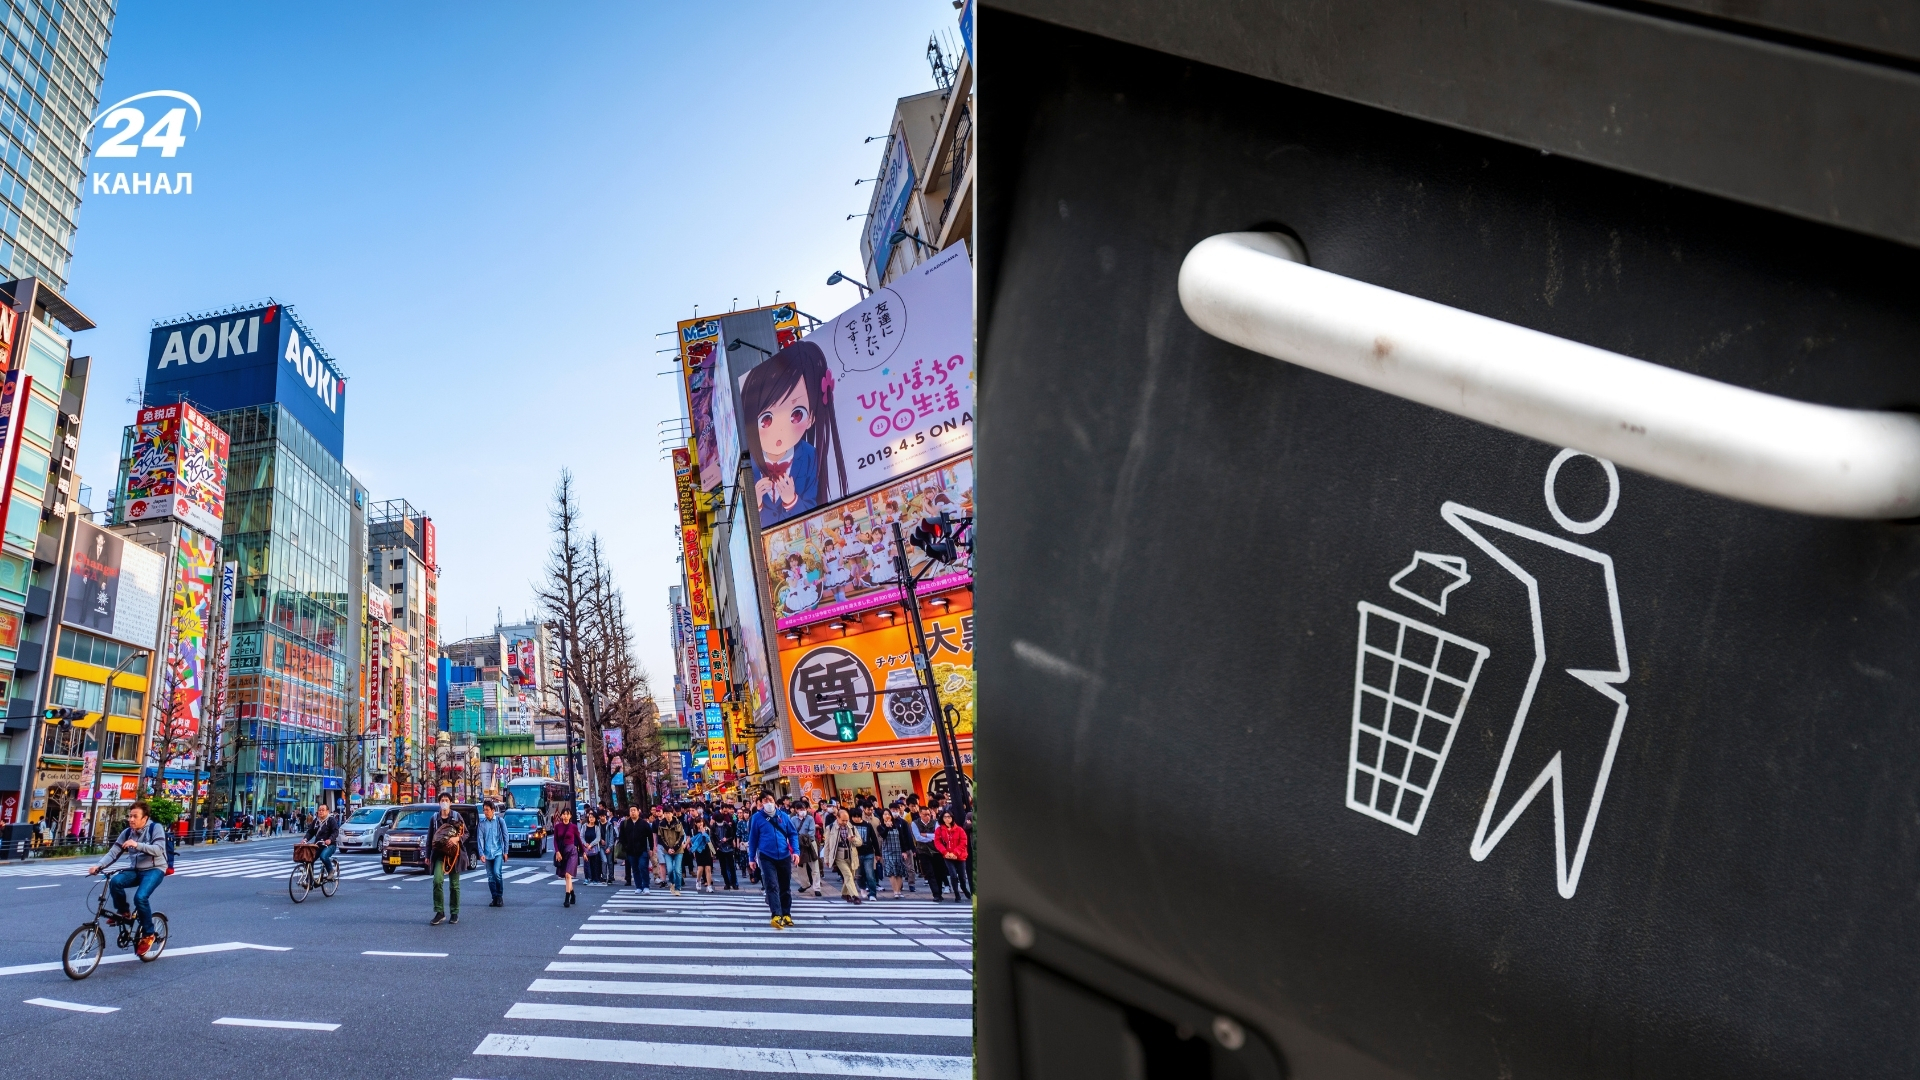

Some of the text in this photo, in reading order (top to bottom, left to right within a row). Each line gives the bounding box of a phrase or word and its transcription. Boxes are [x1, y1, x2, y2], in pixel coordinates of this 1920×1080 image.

[929, 253, 959, 274] KADOKAWA
[861, 312, 880, 356] なりたい
[875, 300, 894, 338] 友達に
[157, 316, 260, 370] AOKI
[285, 327, 337, 415] AOKI
[857, 354, 965, 412] ひとりぼっちの
[143, 407, 177, 422] 免税店
[857, 431, 925, 470] 2019.4.5
[929, 417, 958, 438] ON
[73, 564, 99, 582] AGA
[223, 565, 234, 601] AKKY
[683, 608, 693, 634] AKKY
[234, 647, 255, 655] OPEN
[687, 645, 701, 711] Tax-free Shop
[286, 739, 315, 767] AOKI
[123, 781, 137, 791] au
